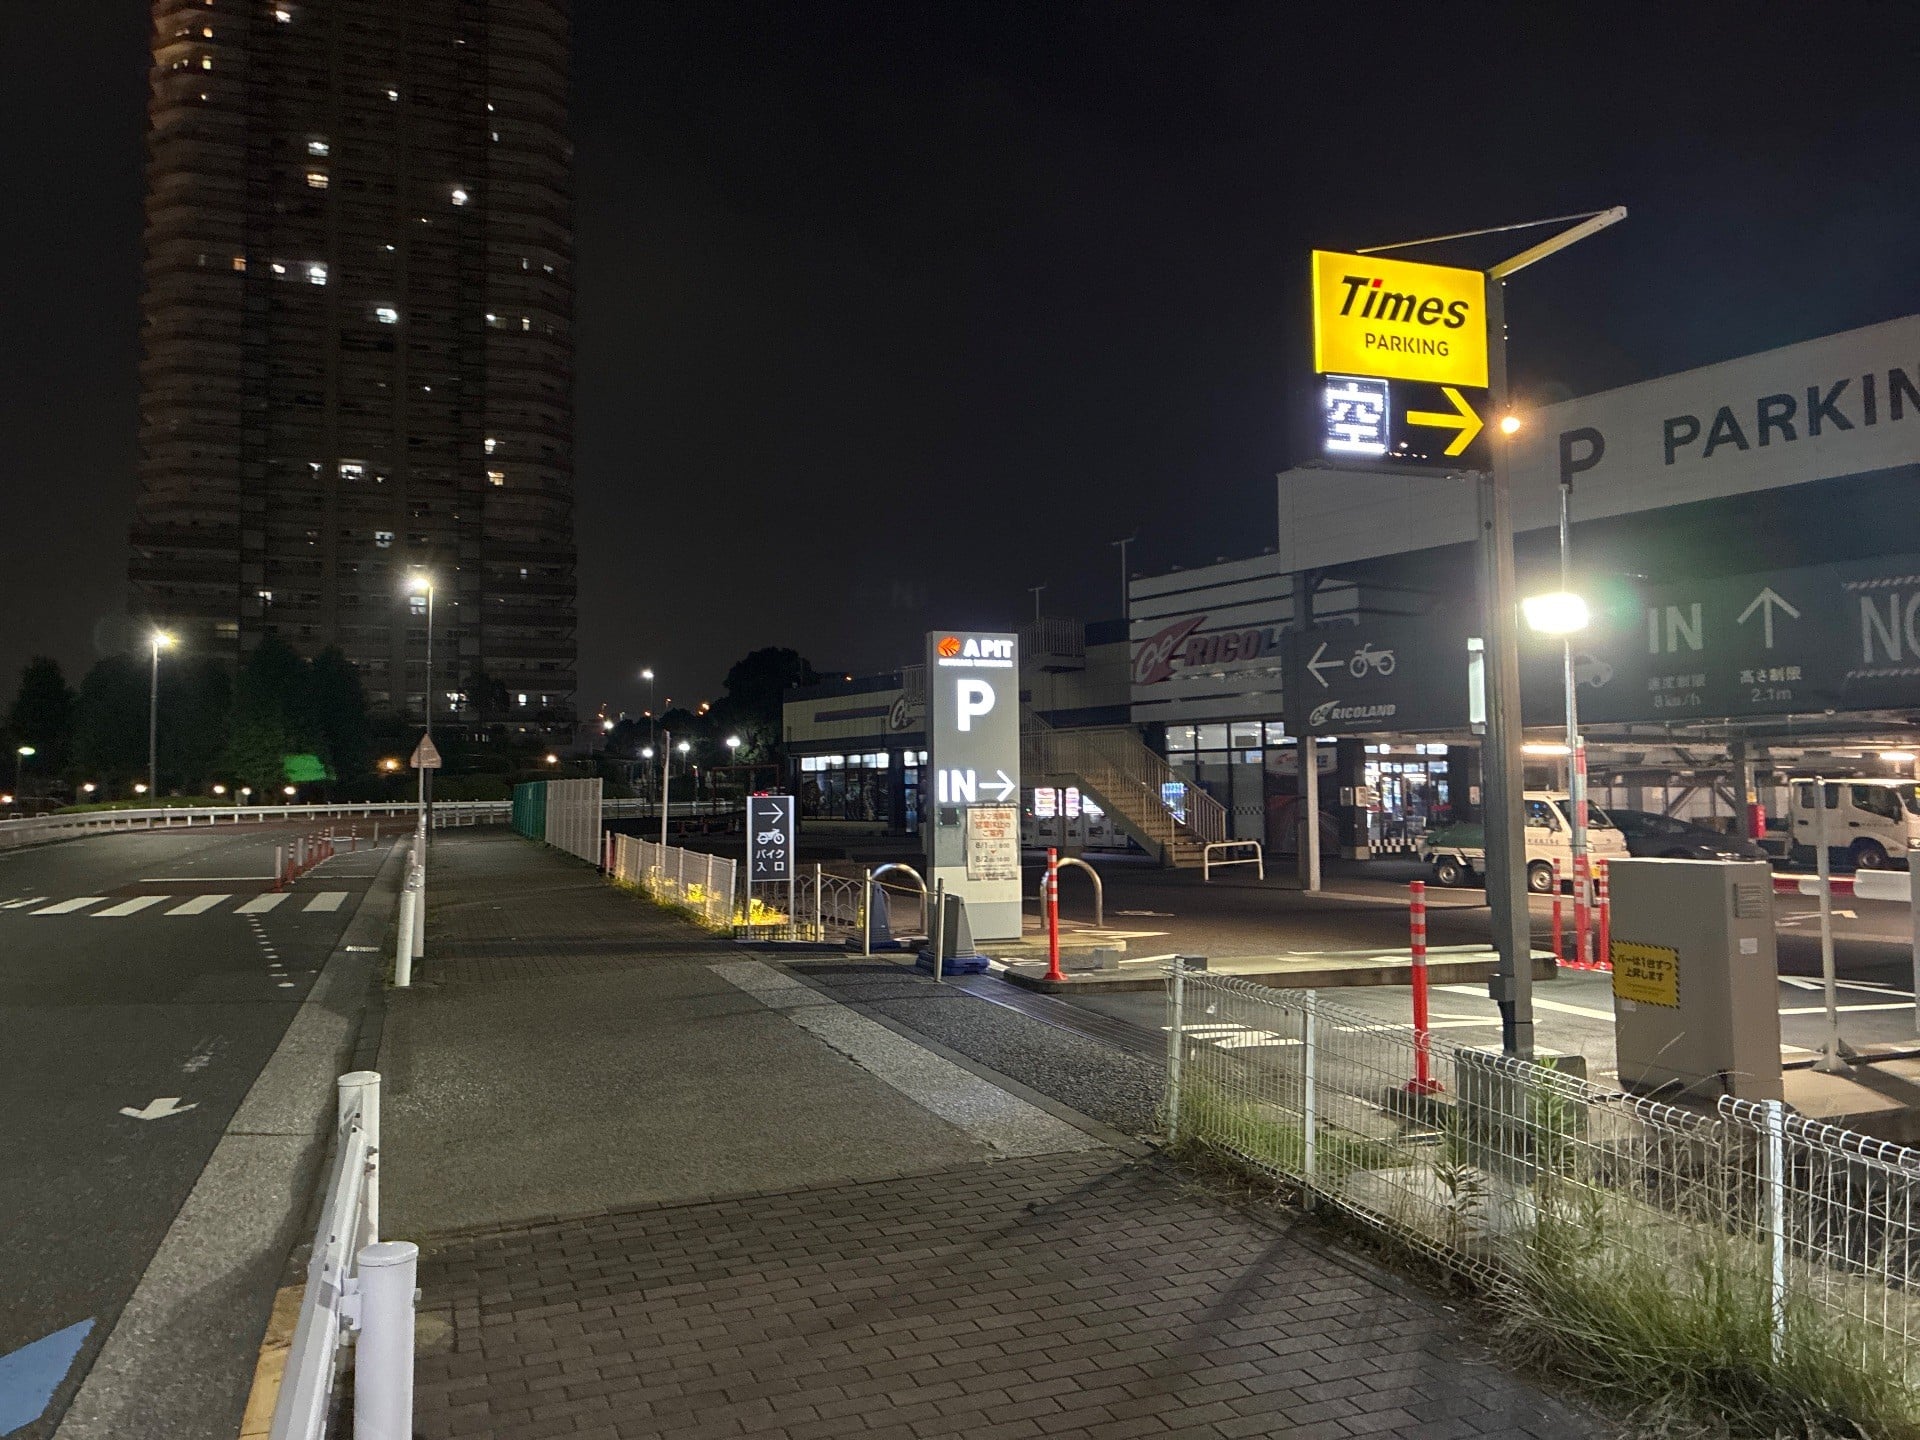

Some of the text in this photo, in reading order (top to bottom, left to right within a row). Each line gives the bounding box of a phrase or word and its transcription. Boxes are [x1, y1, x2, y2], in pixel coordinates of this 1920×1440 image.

[1340, 275, 1469, 329] Times
[1365, 333, 1450, 356] PARKING
[1326, 382, 1386, 453] 空
[1559, 426, 1605, 494] P
[1649, 603, 1703, 653] IN
[963, 638, 1014, 658] APIT
[1740, 666, 1801, 684] 高さ制限
[957, 679, 995, 731] P
[1752, 688, 1792, 702] 2.1m
[1331, 704, 1396, 719] RICOLAND
[938, 769, 976, 803] IN
[756, 849, 785, 859] バイク
[1625, 967, 1665, 982] 上昇します
